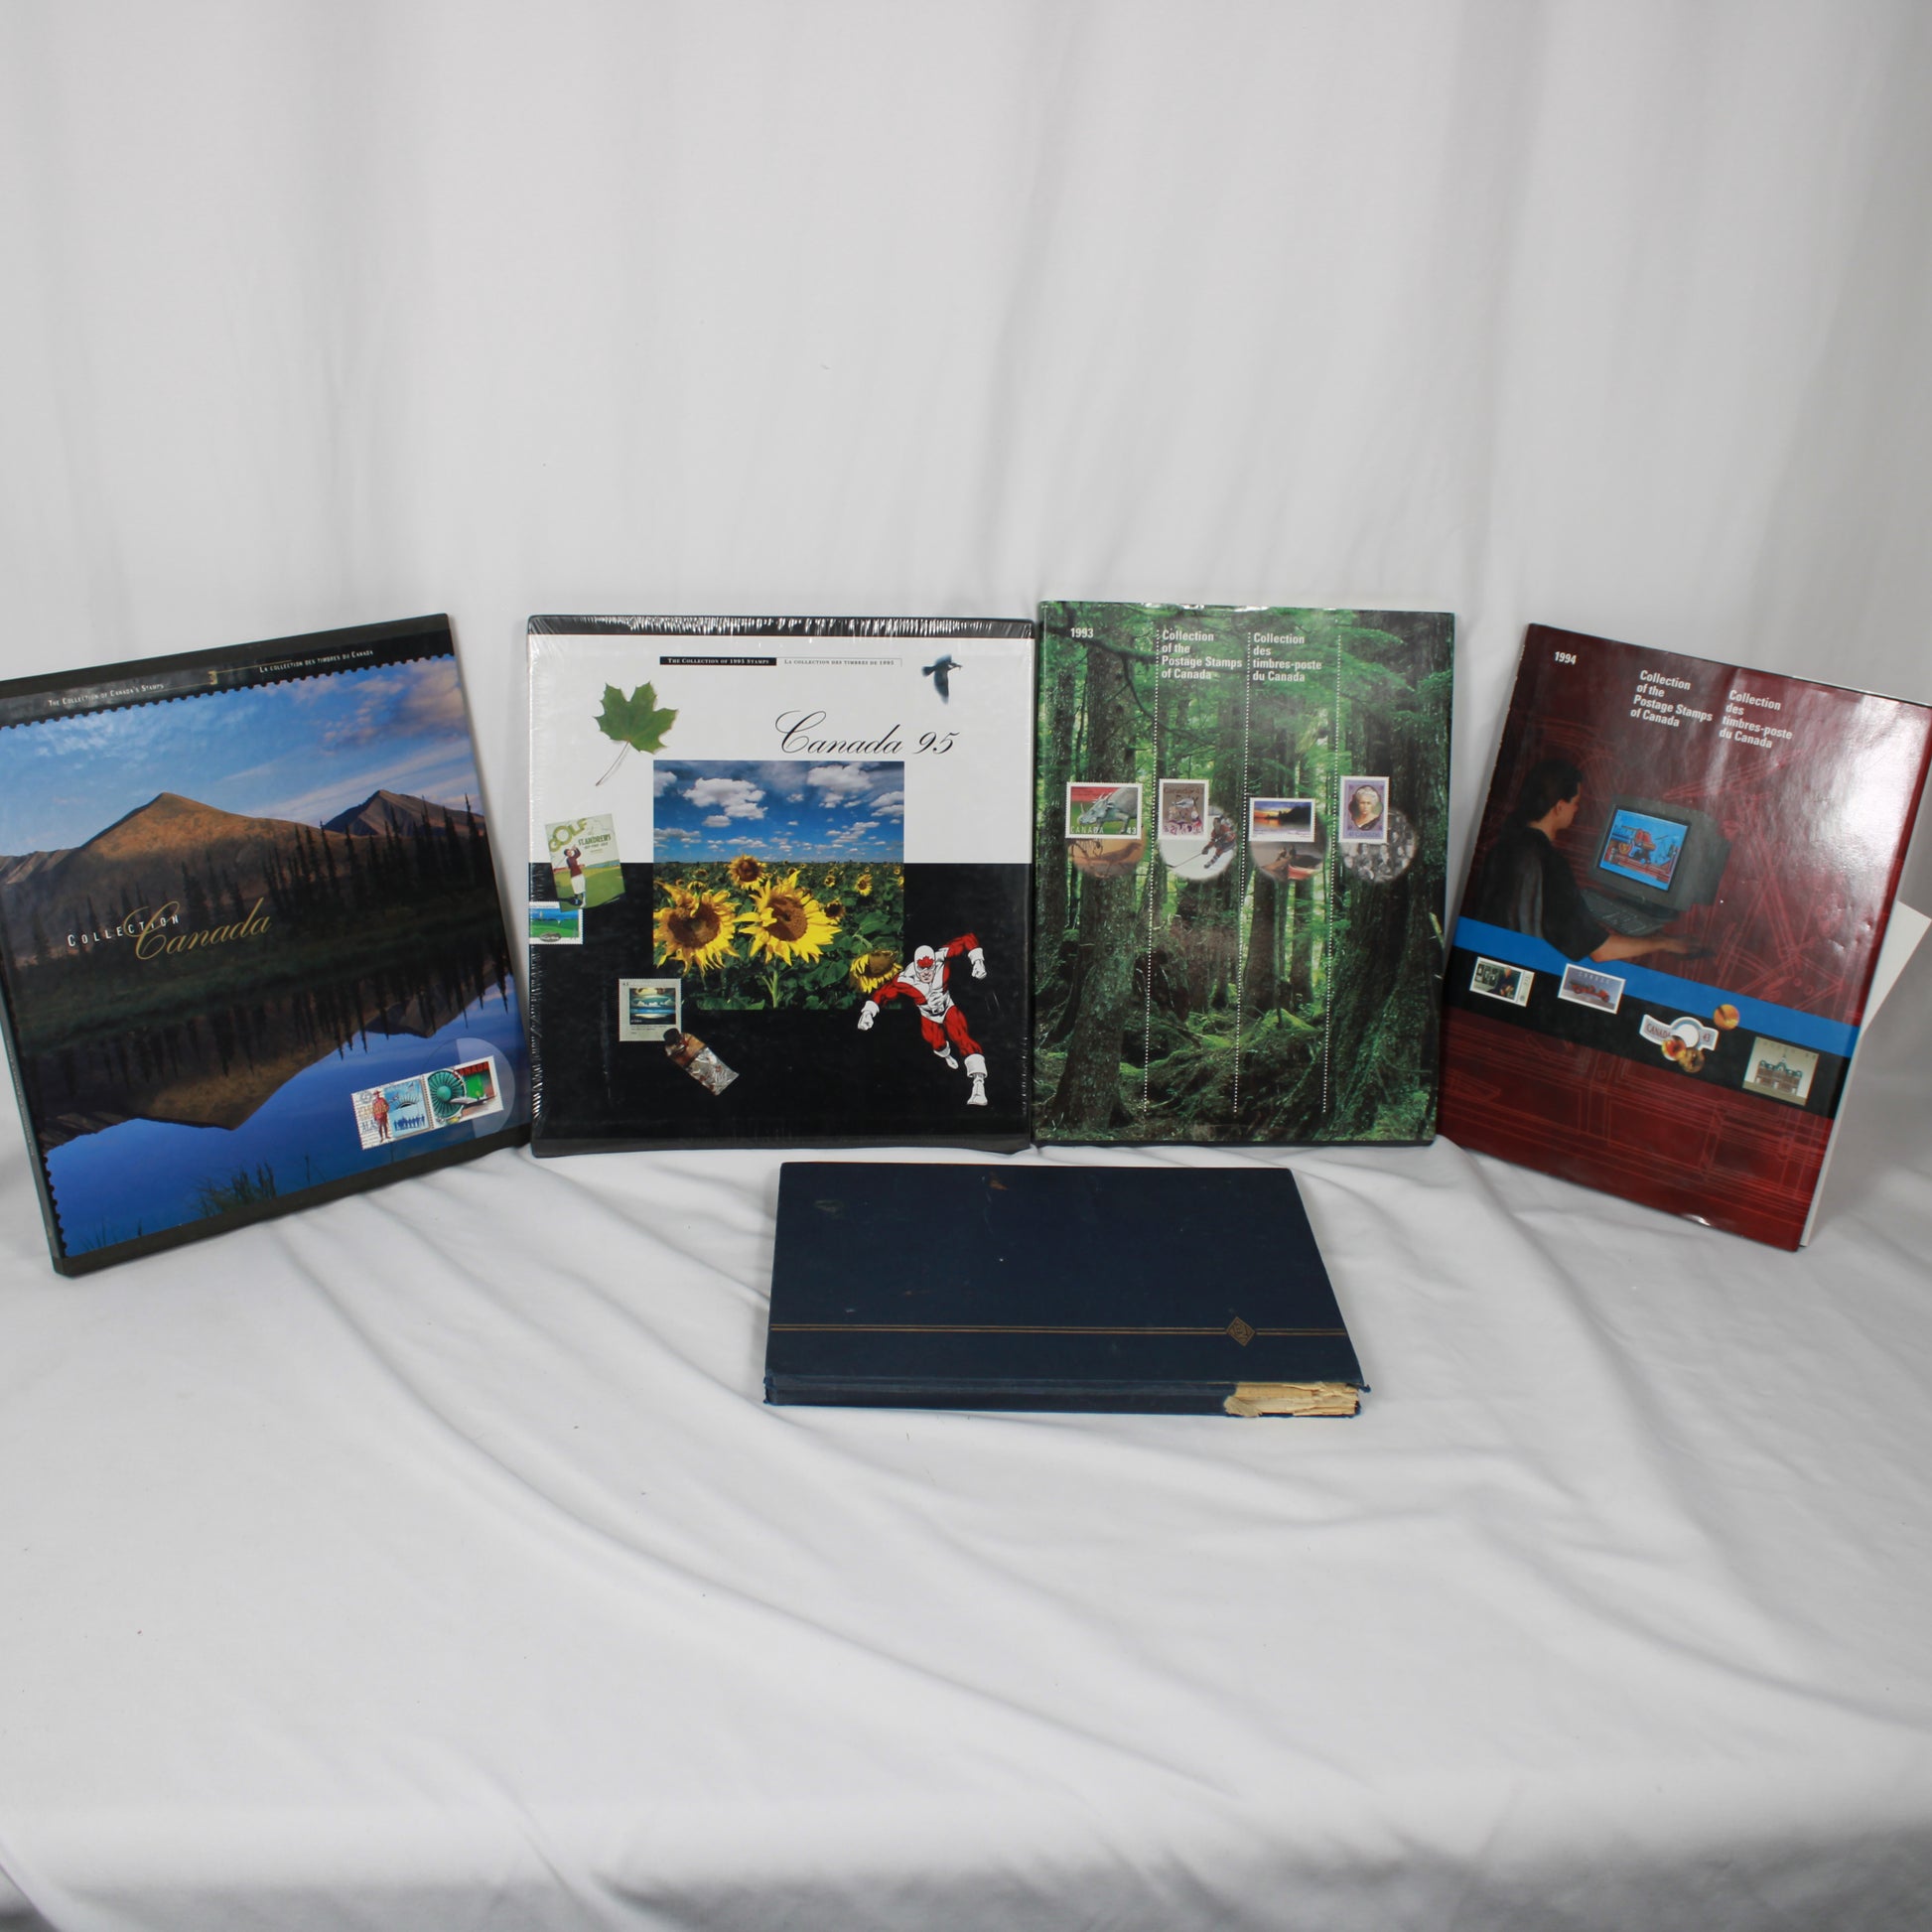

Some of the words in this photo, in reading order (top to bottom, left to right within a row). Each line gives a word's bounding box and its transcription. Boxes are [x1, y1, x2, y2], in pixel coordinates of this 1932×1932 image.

[1070, 627, 1094, 639] 1993
[1162, 629, 1214, 642] Collection
[1253, 632, 1306, 645] Collection
[1162, 642, 1173, 653] of
[1173, 643, 1191, 654] the
[1253, 645, 1272, 656] des
[1162, 655, 1203, 669] Postage
[1205, 656, 1243, 669] Stamps
[1554, 650, 1577, 665] 1994
[1253, 658, 1322, 672] timbres-poste
[1162, 668, 1173, 680] of
[1173, 669, 1212, 680] Canada
[1253, 671, 1266, 682] du
[1268, 671, 1306, 683] Canada
[1639, 669, 1691, 691] Collection
[1636, 683, 1648, 694] of
[1648, 685, 1665, 697] the
[1728, 689, 1782, 711] Collection
[1633, 694, 1674, 715] Postage
[1675, 703, 1714, 722] Stamps
[1725, 704, 1744, 716] des
[1630, 708, 1642, 719] of
[1642, 710, 1680, 728] Canada
[774, 710, 904, 755] Canada
[912, 731, 960, 755] 95
[1722, 715, 1793, 741] timbres-poste
[1719, 728, 1732, 740] du
[1734, 731, 1773, 750] Canada
[67, 913, 180, 947] COLLECTION
[123, 897, 271, 960] Canada
